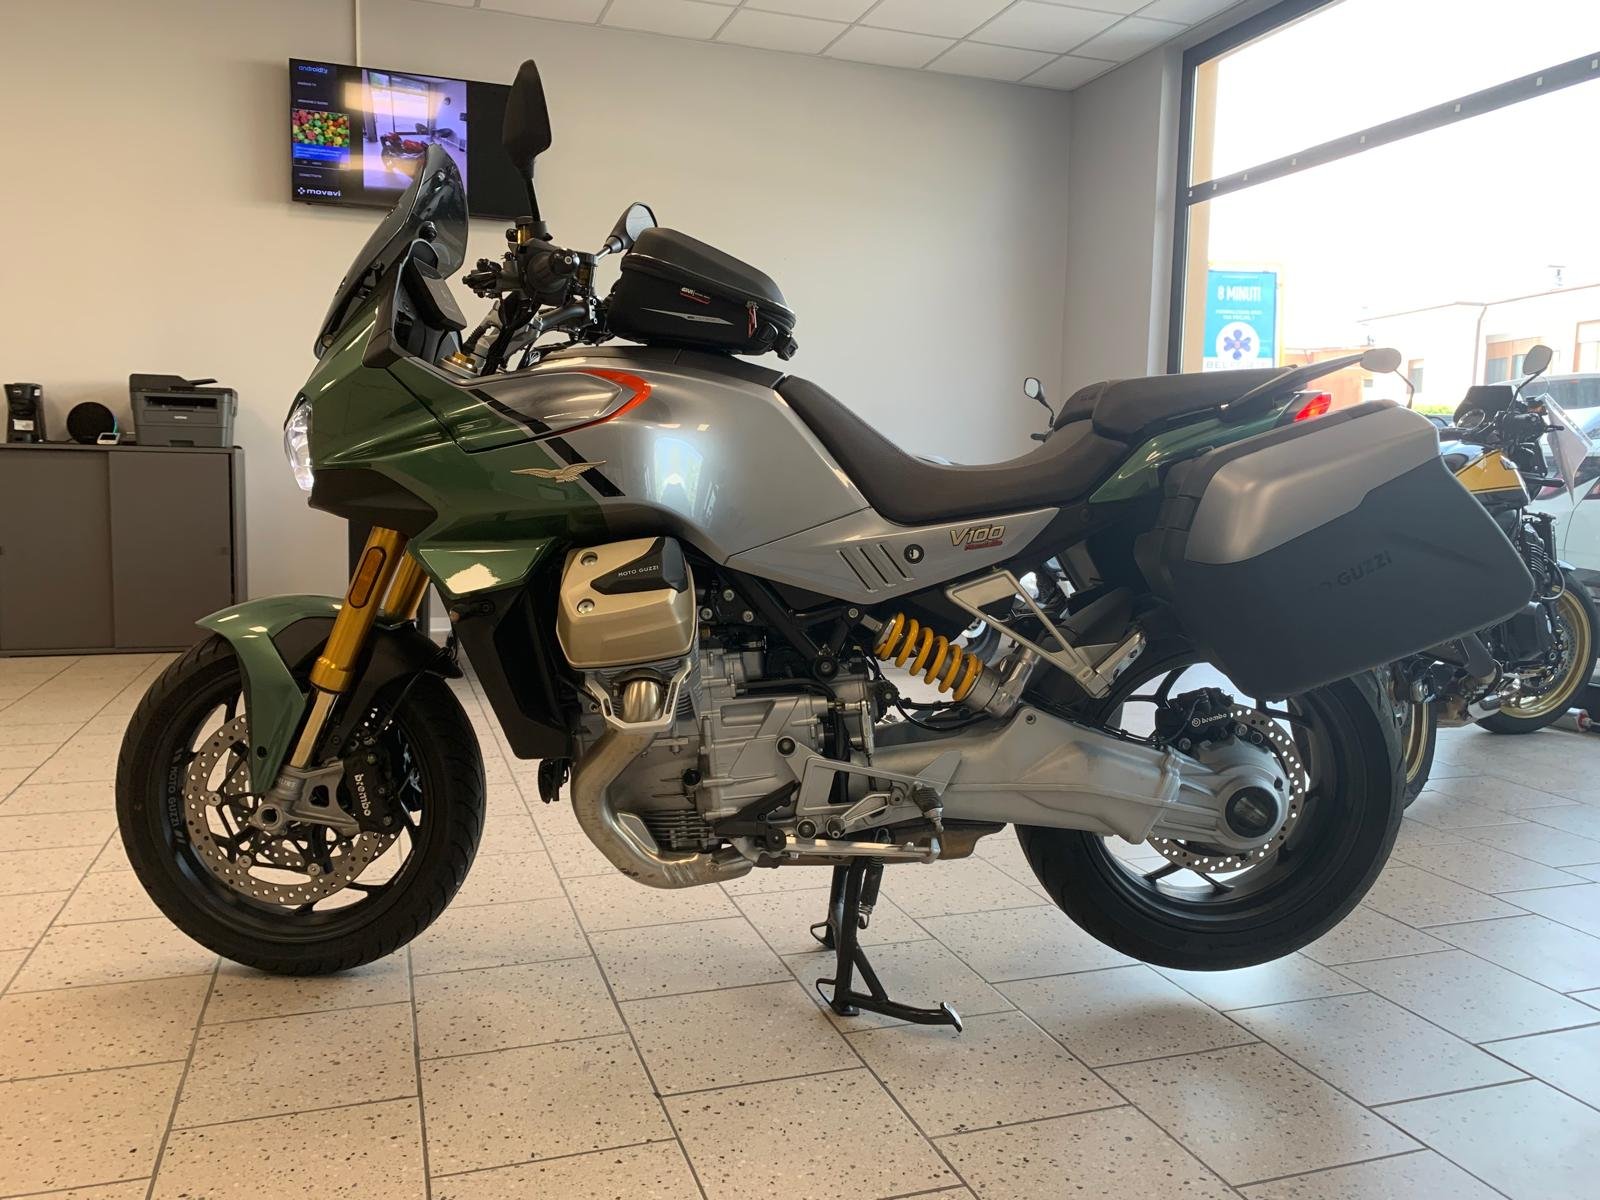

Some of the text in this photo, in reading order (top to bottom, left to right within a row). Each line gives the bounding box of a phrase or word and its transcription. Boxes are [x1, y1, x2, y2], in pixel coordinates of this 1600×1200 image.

[306, 188, 341, 197] movavi
[1226, 285, 1262, 302] MINUTI
[950, 525, 1005, 547] V100
[618, 565, 659, 577] MOTO GUZZI
[1201, 713, 1228, 724] brembo
[167, 766, 181, 827] MOTO GUZZI
[353, 772, 372, 818] brembo
